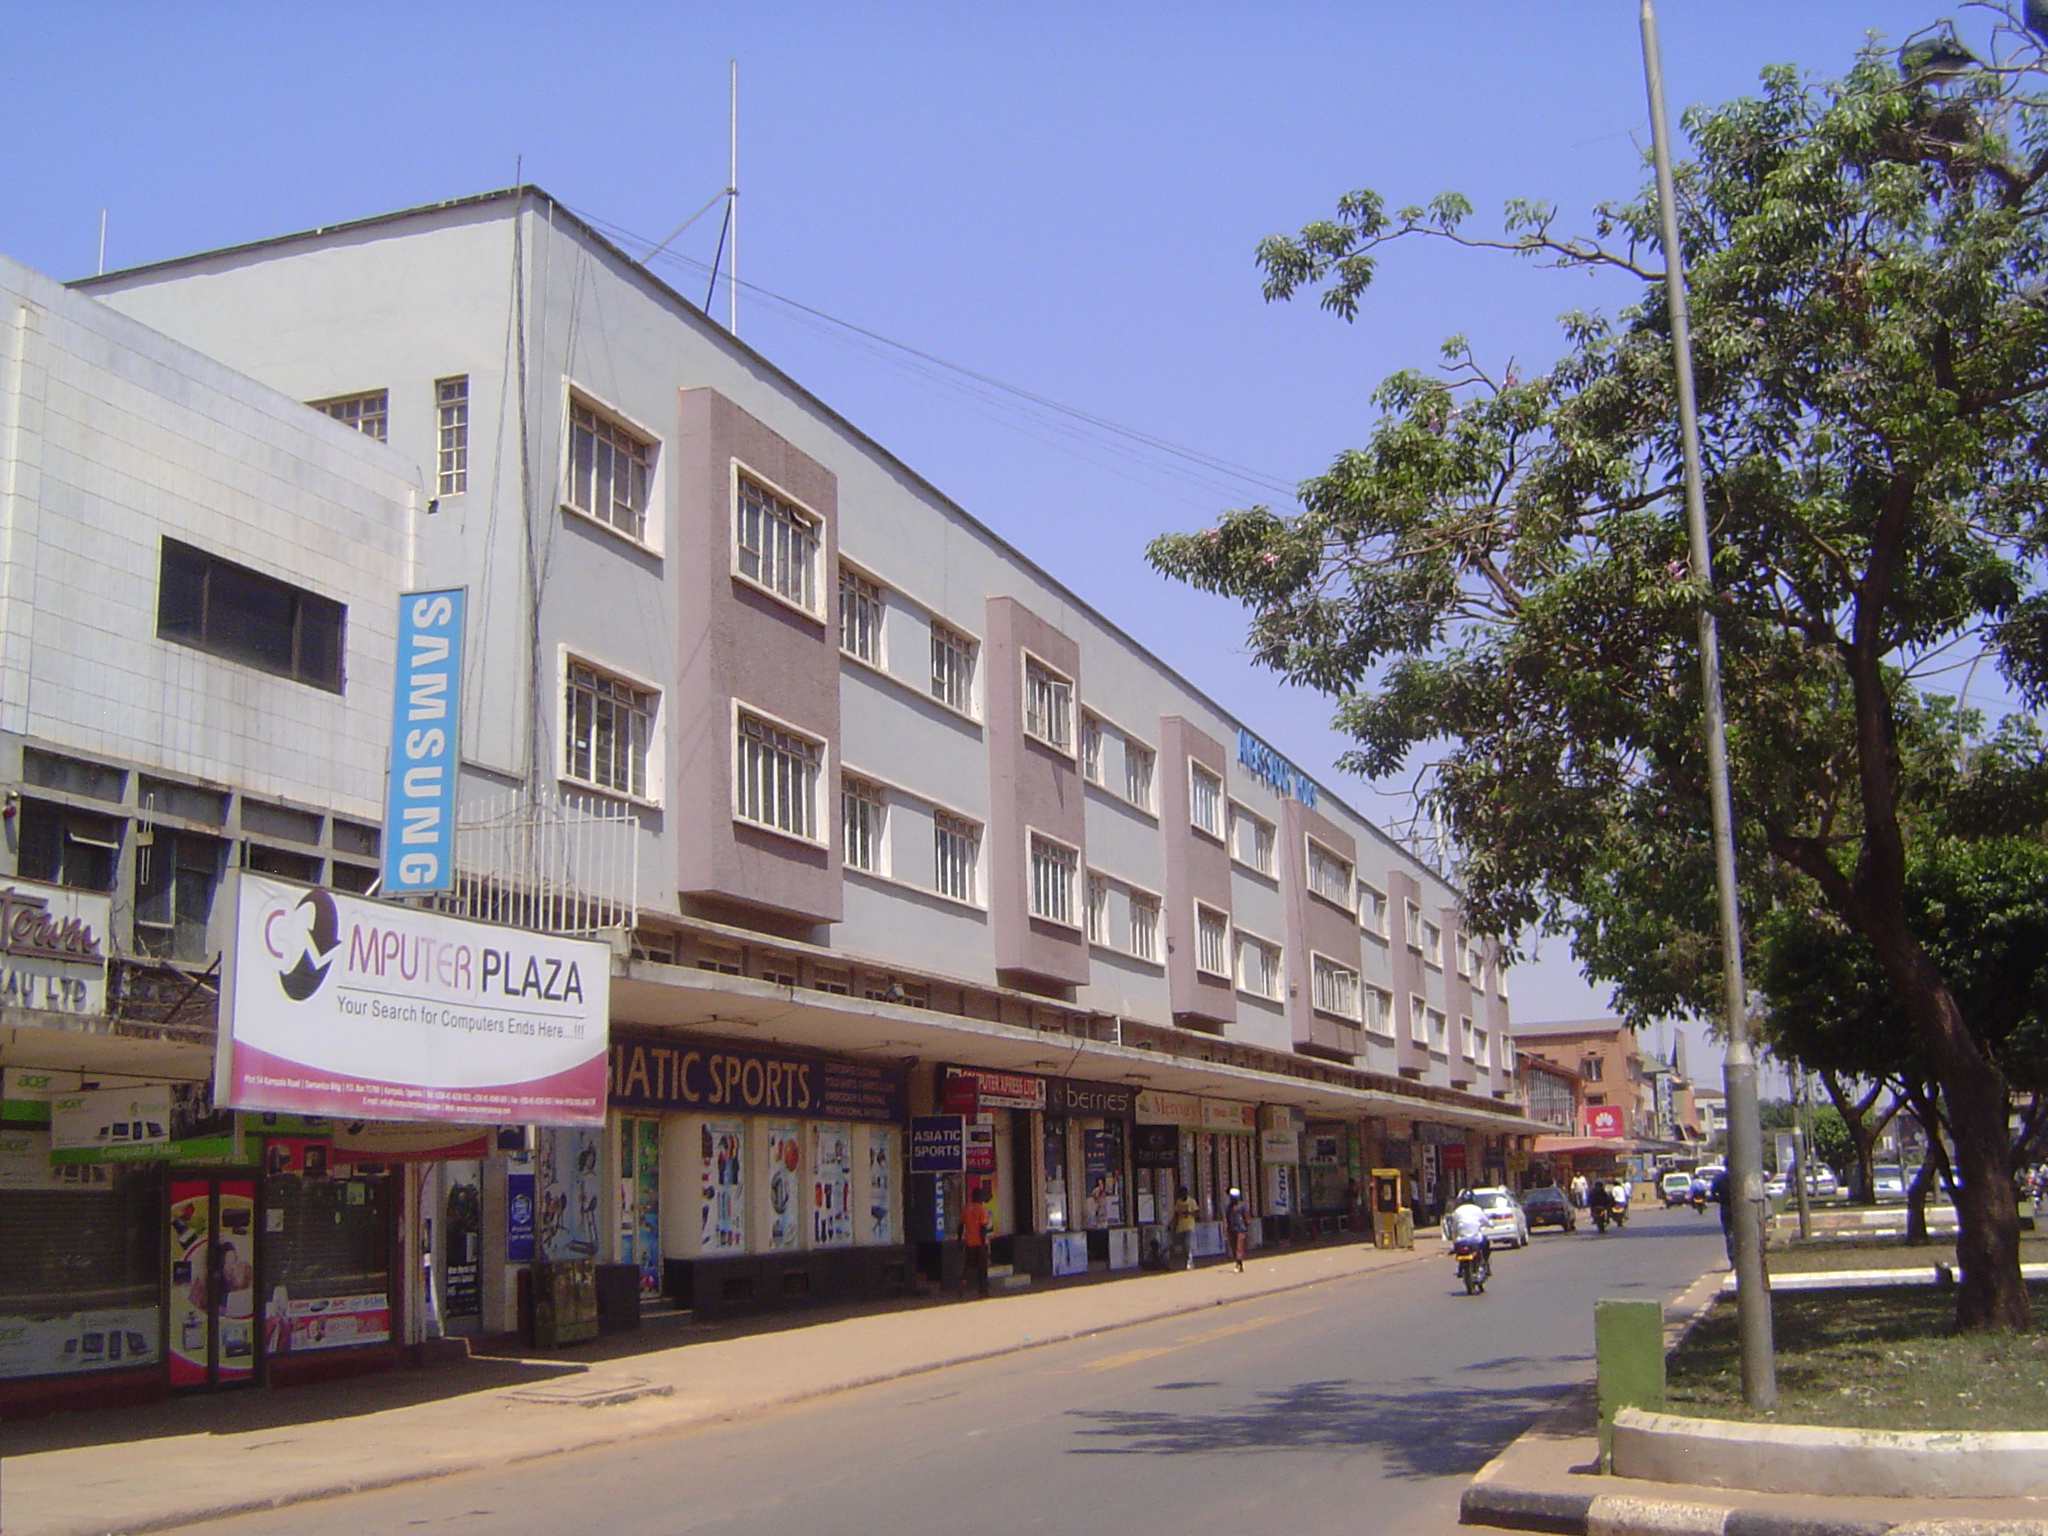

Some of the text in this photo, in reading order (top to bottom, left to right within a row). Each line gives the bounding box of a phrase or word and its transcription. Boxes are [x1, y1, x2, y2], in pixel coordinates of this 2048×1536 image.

[399, 595, 453, 885] SAMSUNG
[0, 886, 99, 952] Town
[46, 974, 87, 1003] LTD
[481, 947, 584, 1004] PLAZA
[337, 995, 368, 1016] Your
[371, 1000, 418, 1022] Search
[420, 1006, 437, 1025] for
[441, 1010, 504, 1033] Computers
[508, 1018, 536, 1036] Ends
[608, 1044, 810, 1109] IATIC SPORTS
[914, 1130, 961, 1142] ASIATIC
[914, 1145, 960, 1157] SPORTS
